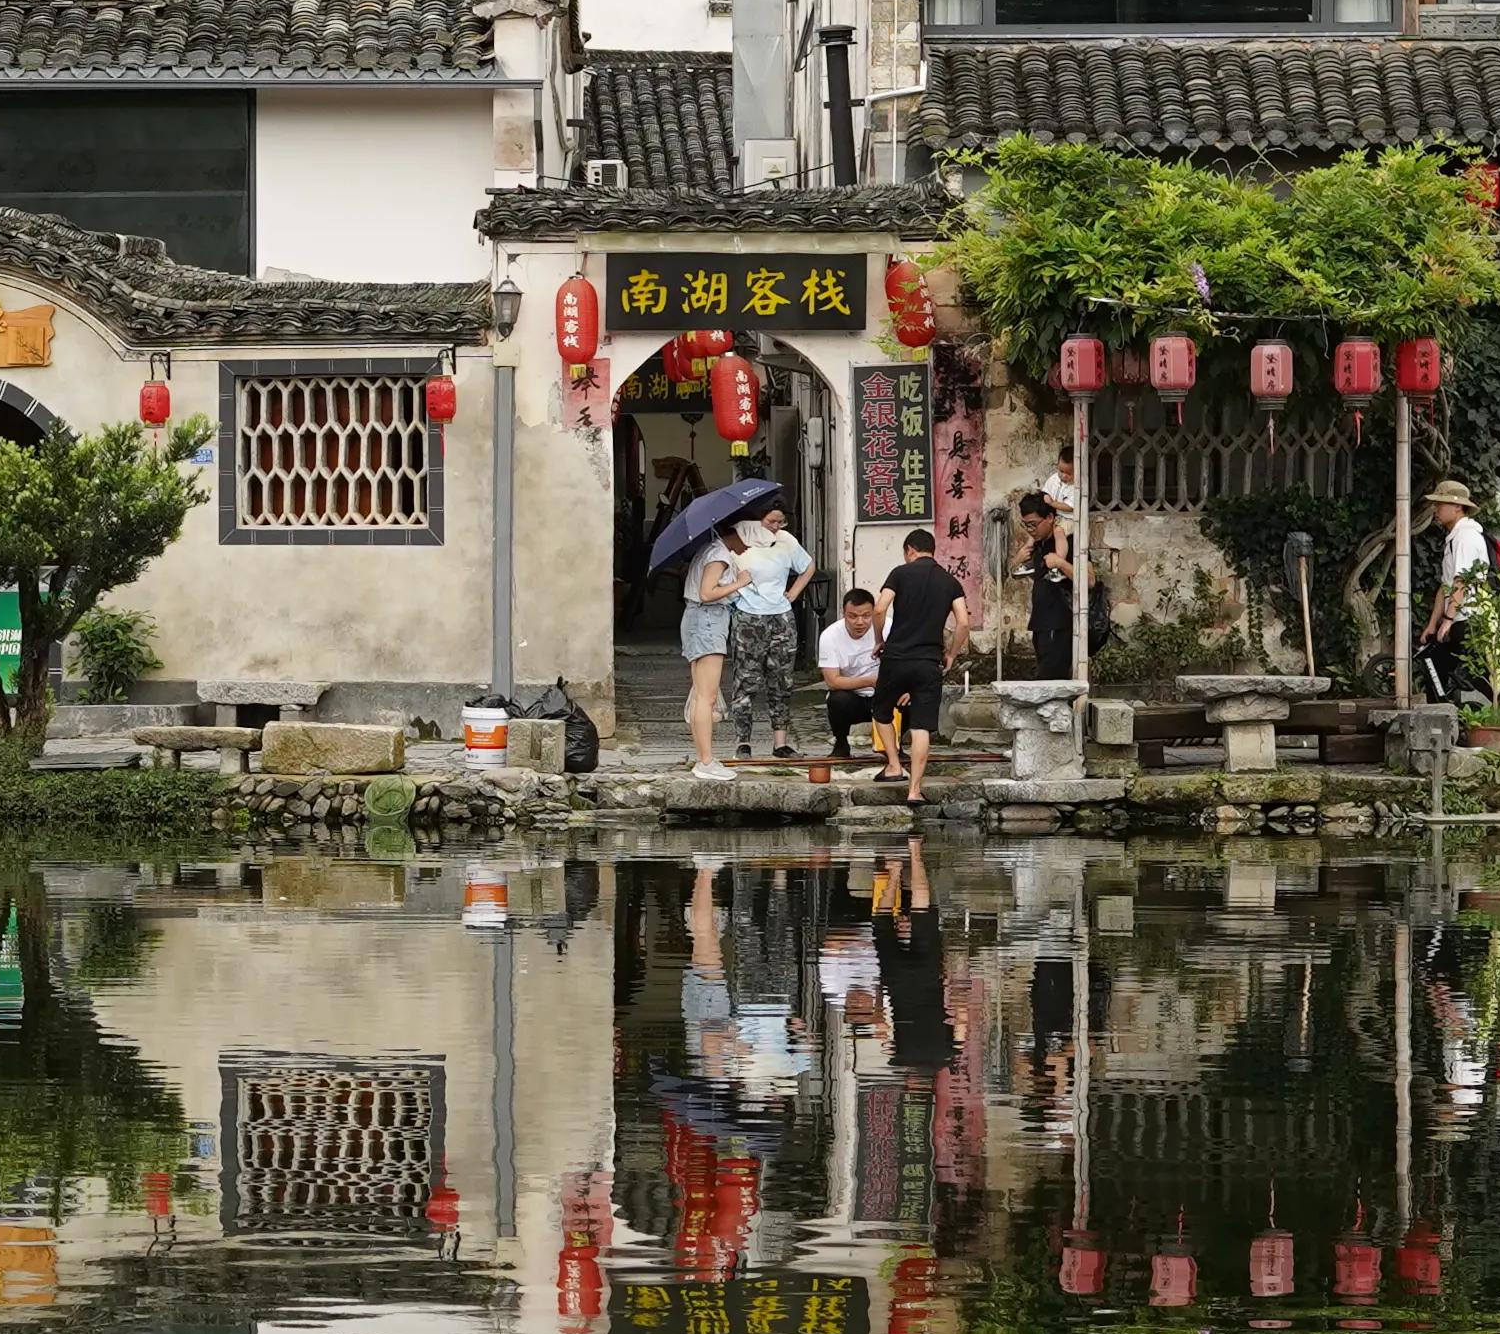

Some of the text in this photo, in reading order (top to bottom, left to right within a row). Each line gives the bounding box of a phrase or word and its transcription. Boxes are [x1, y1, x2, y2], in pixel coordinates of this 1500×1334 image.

[563, 292, 580, 348] 南湖客栈
[621, 268, 851, 316] 南湖客栈
[735, 369, 754, 425] 南湖客栈
[861, 371, 900, 517] 金银花客栈
[899, 371, 926, 515] 吃饭 住宿
